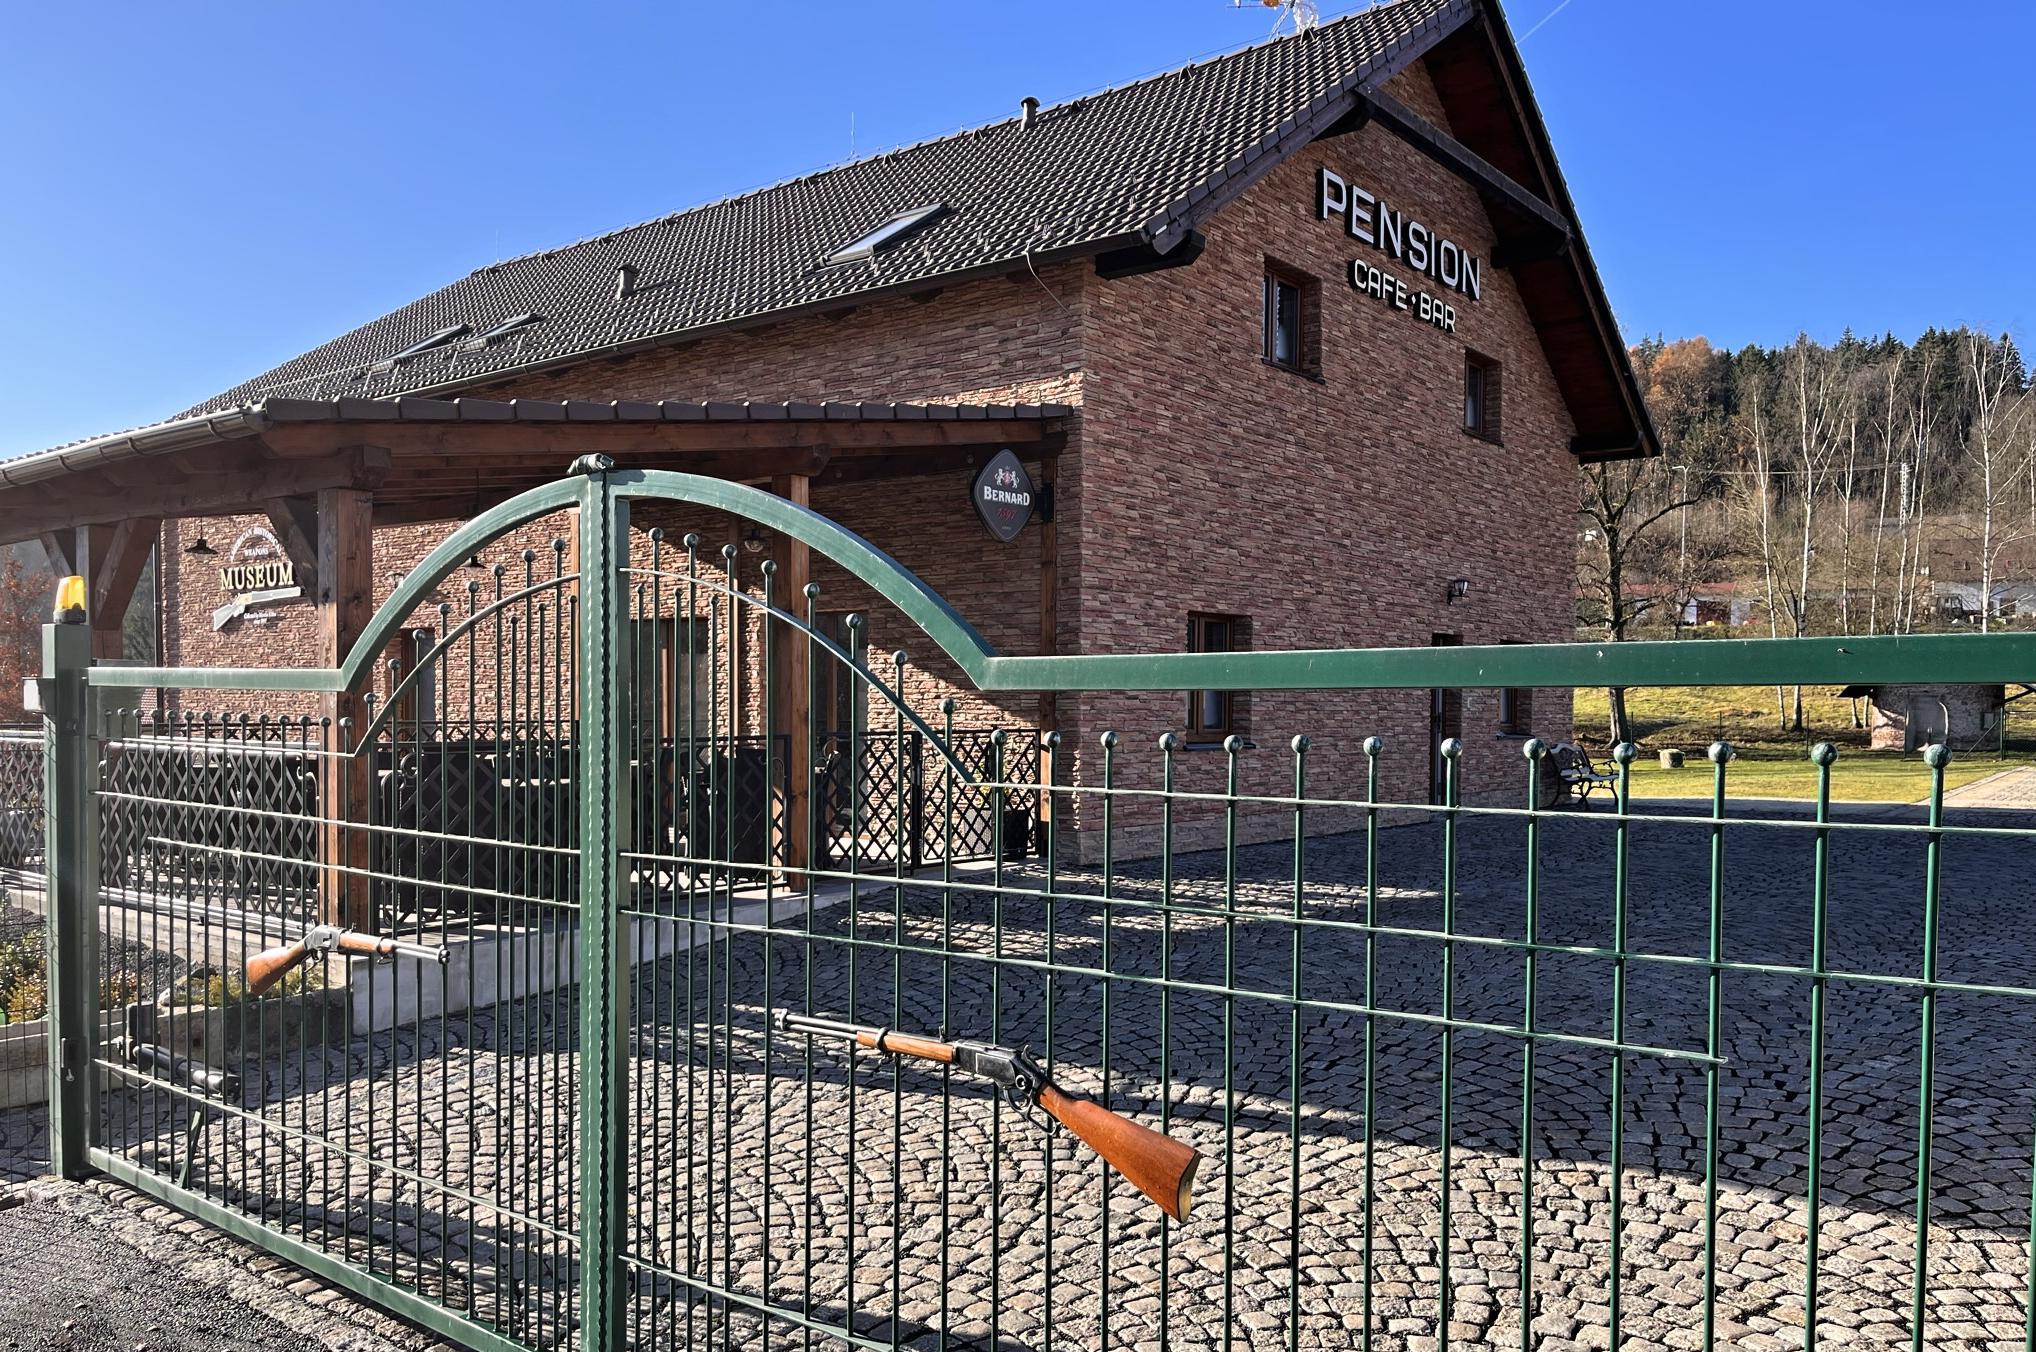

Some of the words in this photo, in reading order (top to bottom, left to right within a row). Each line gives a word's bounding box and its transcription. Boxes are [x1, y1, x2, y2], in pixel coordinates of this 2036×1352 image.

[1322, 168, 1481, 300] PENSION
[1354, 259, 1408, 310] CAFE
[1419, 291, 1456, 333] BAR
[983, 485, 1031, 506] BERNARD
[220, 560, 295, 591] MUSEUM
